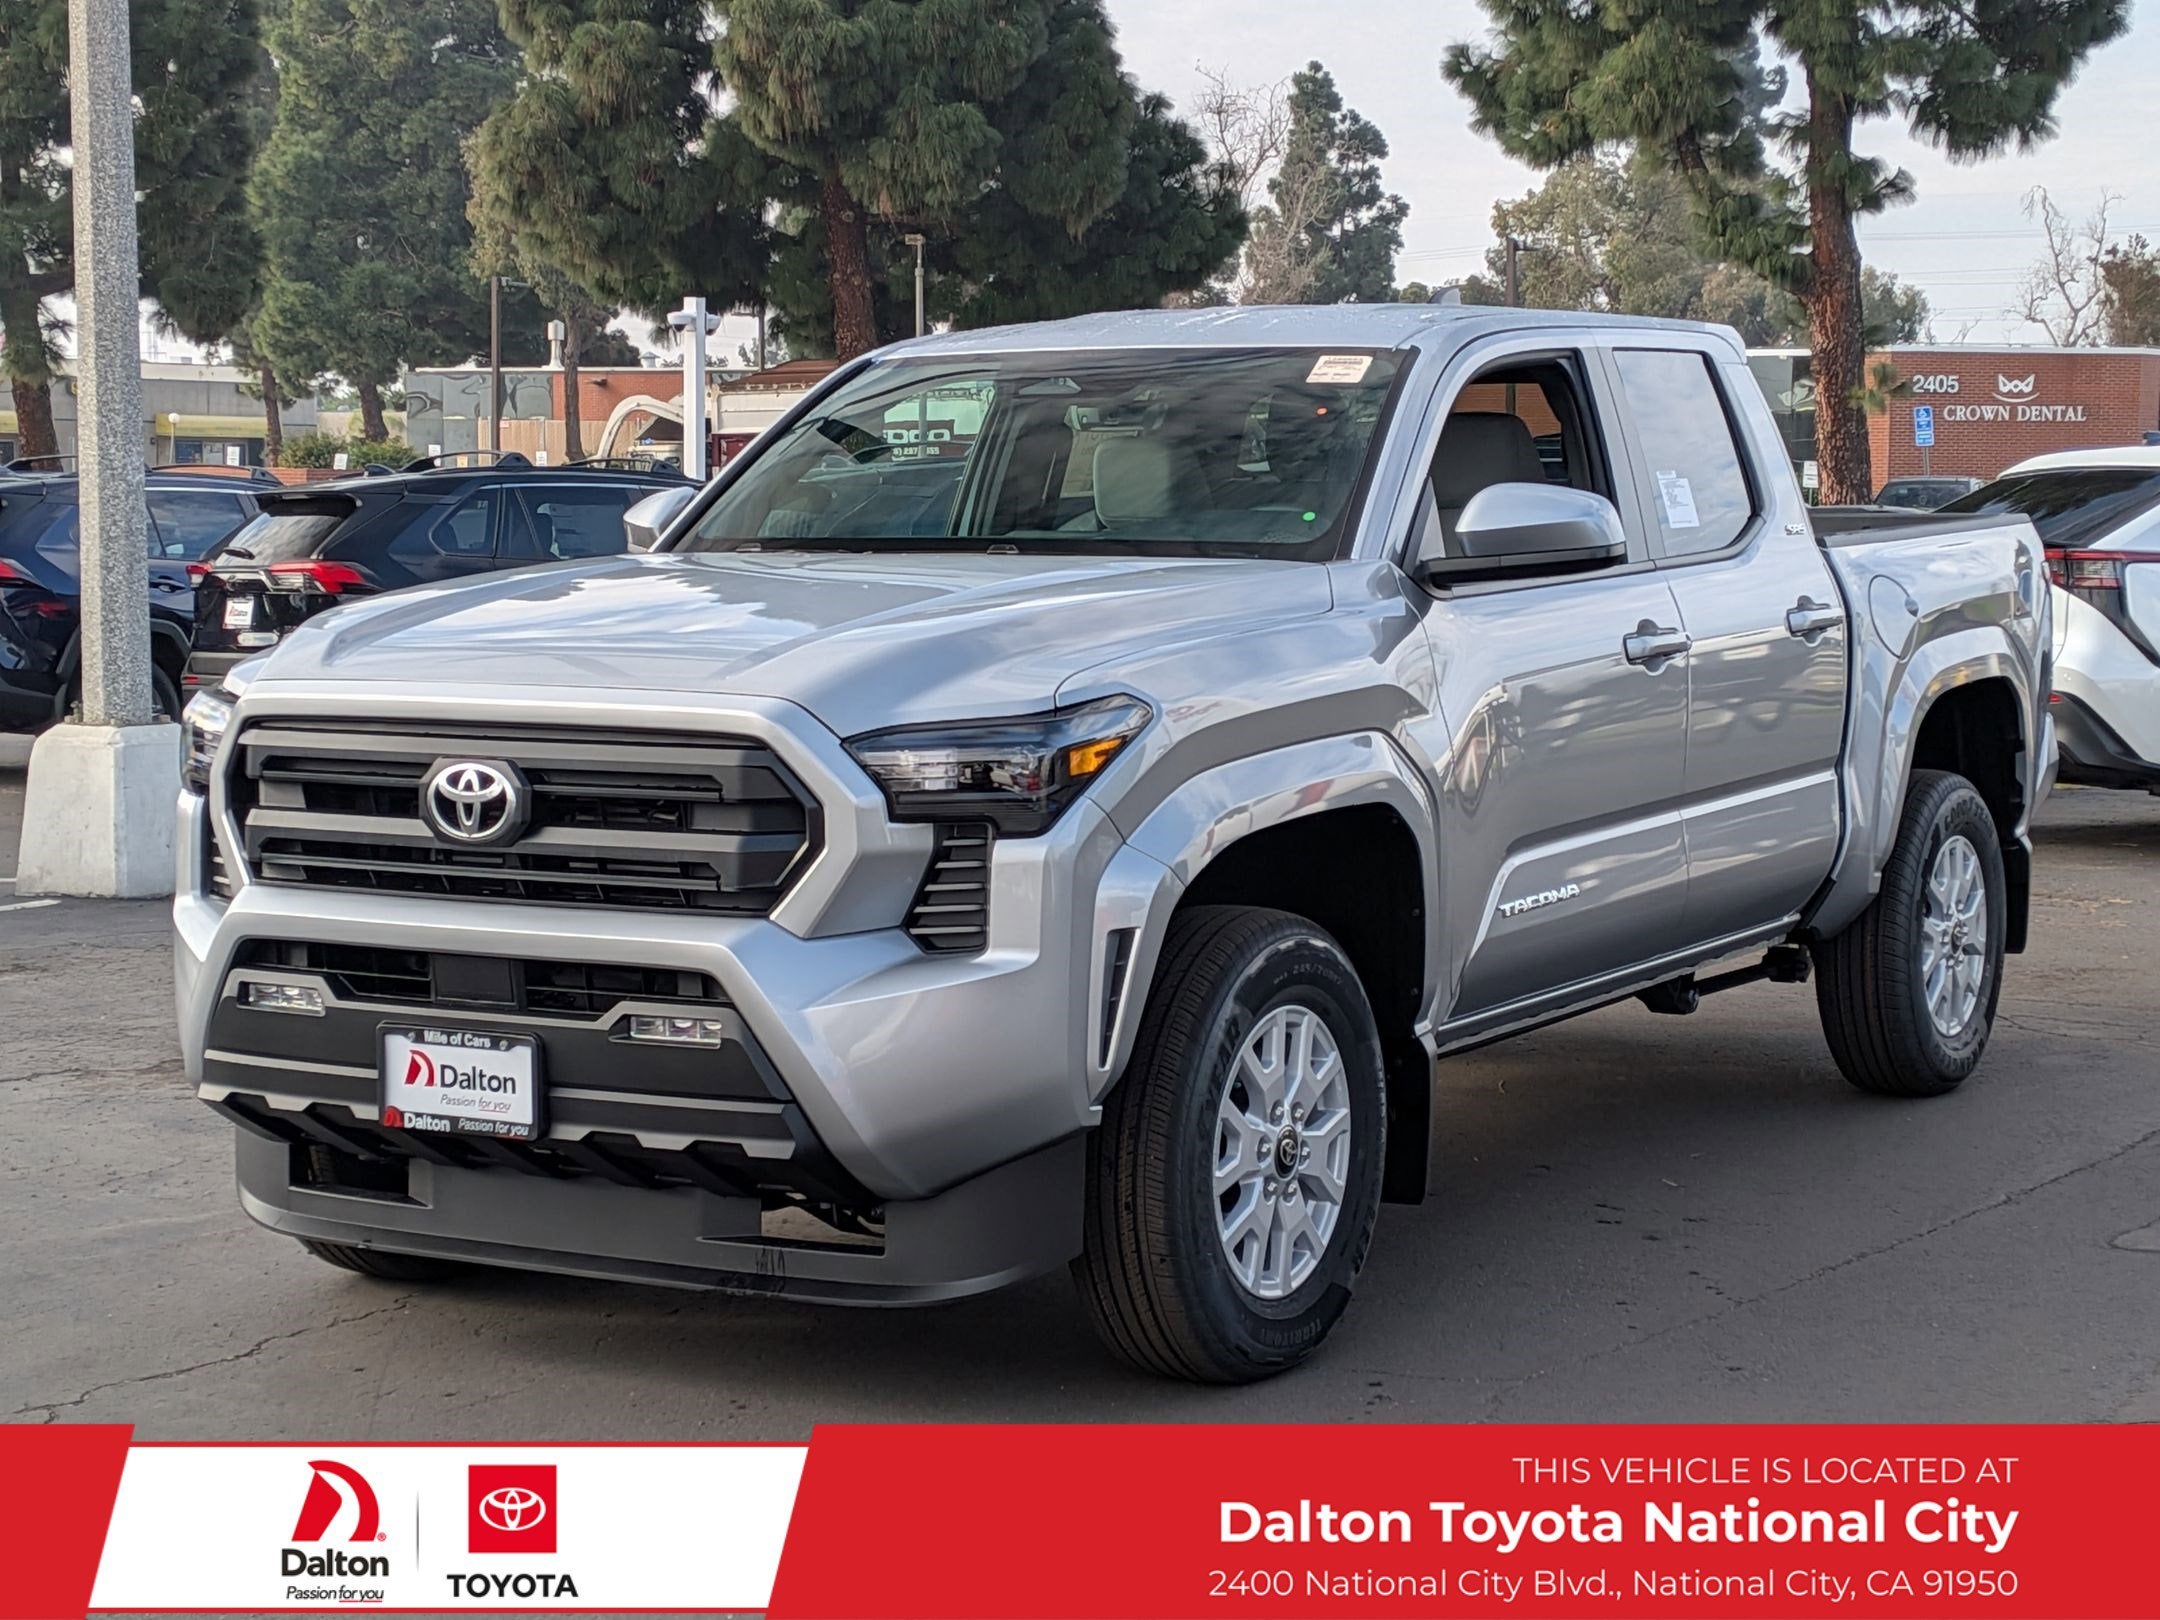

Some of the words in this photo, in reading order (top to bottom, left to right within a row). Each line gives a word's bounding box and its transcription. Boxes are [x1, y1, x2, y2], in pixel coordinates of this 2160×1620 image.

[1912, 375, 1960, 393] 2405
[1943, 405, 2010, 422] CROWN
[2016, 405, 2087, 422] DENTAL
[1498, 883, 1580, 917] TACOMA
[423, 1030, 448, 1044] Mile
[449, 1033, 462, 1046] of
[464, 1033, 491, 1048] Cars
[440, 1064, 516, 1094] Dalton
[440, 1094, 476, 1107] Passion
[478, 1097, 491, 1109] for
[493, 1101, 511, 1111] you
[403, 1112, 450, 1132] Dalton
[458, 1118, 494, 1132] Passion
[495, 1121, 509, 1134] for
[510, 1124, 529, 1137] you
